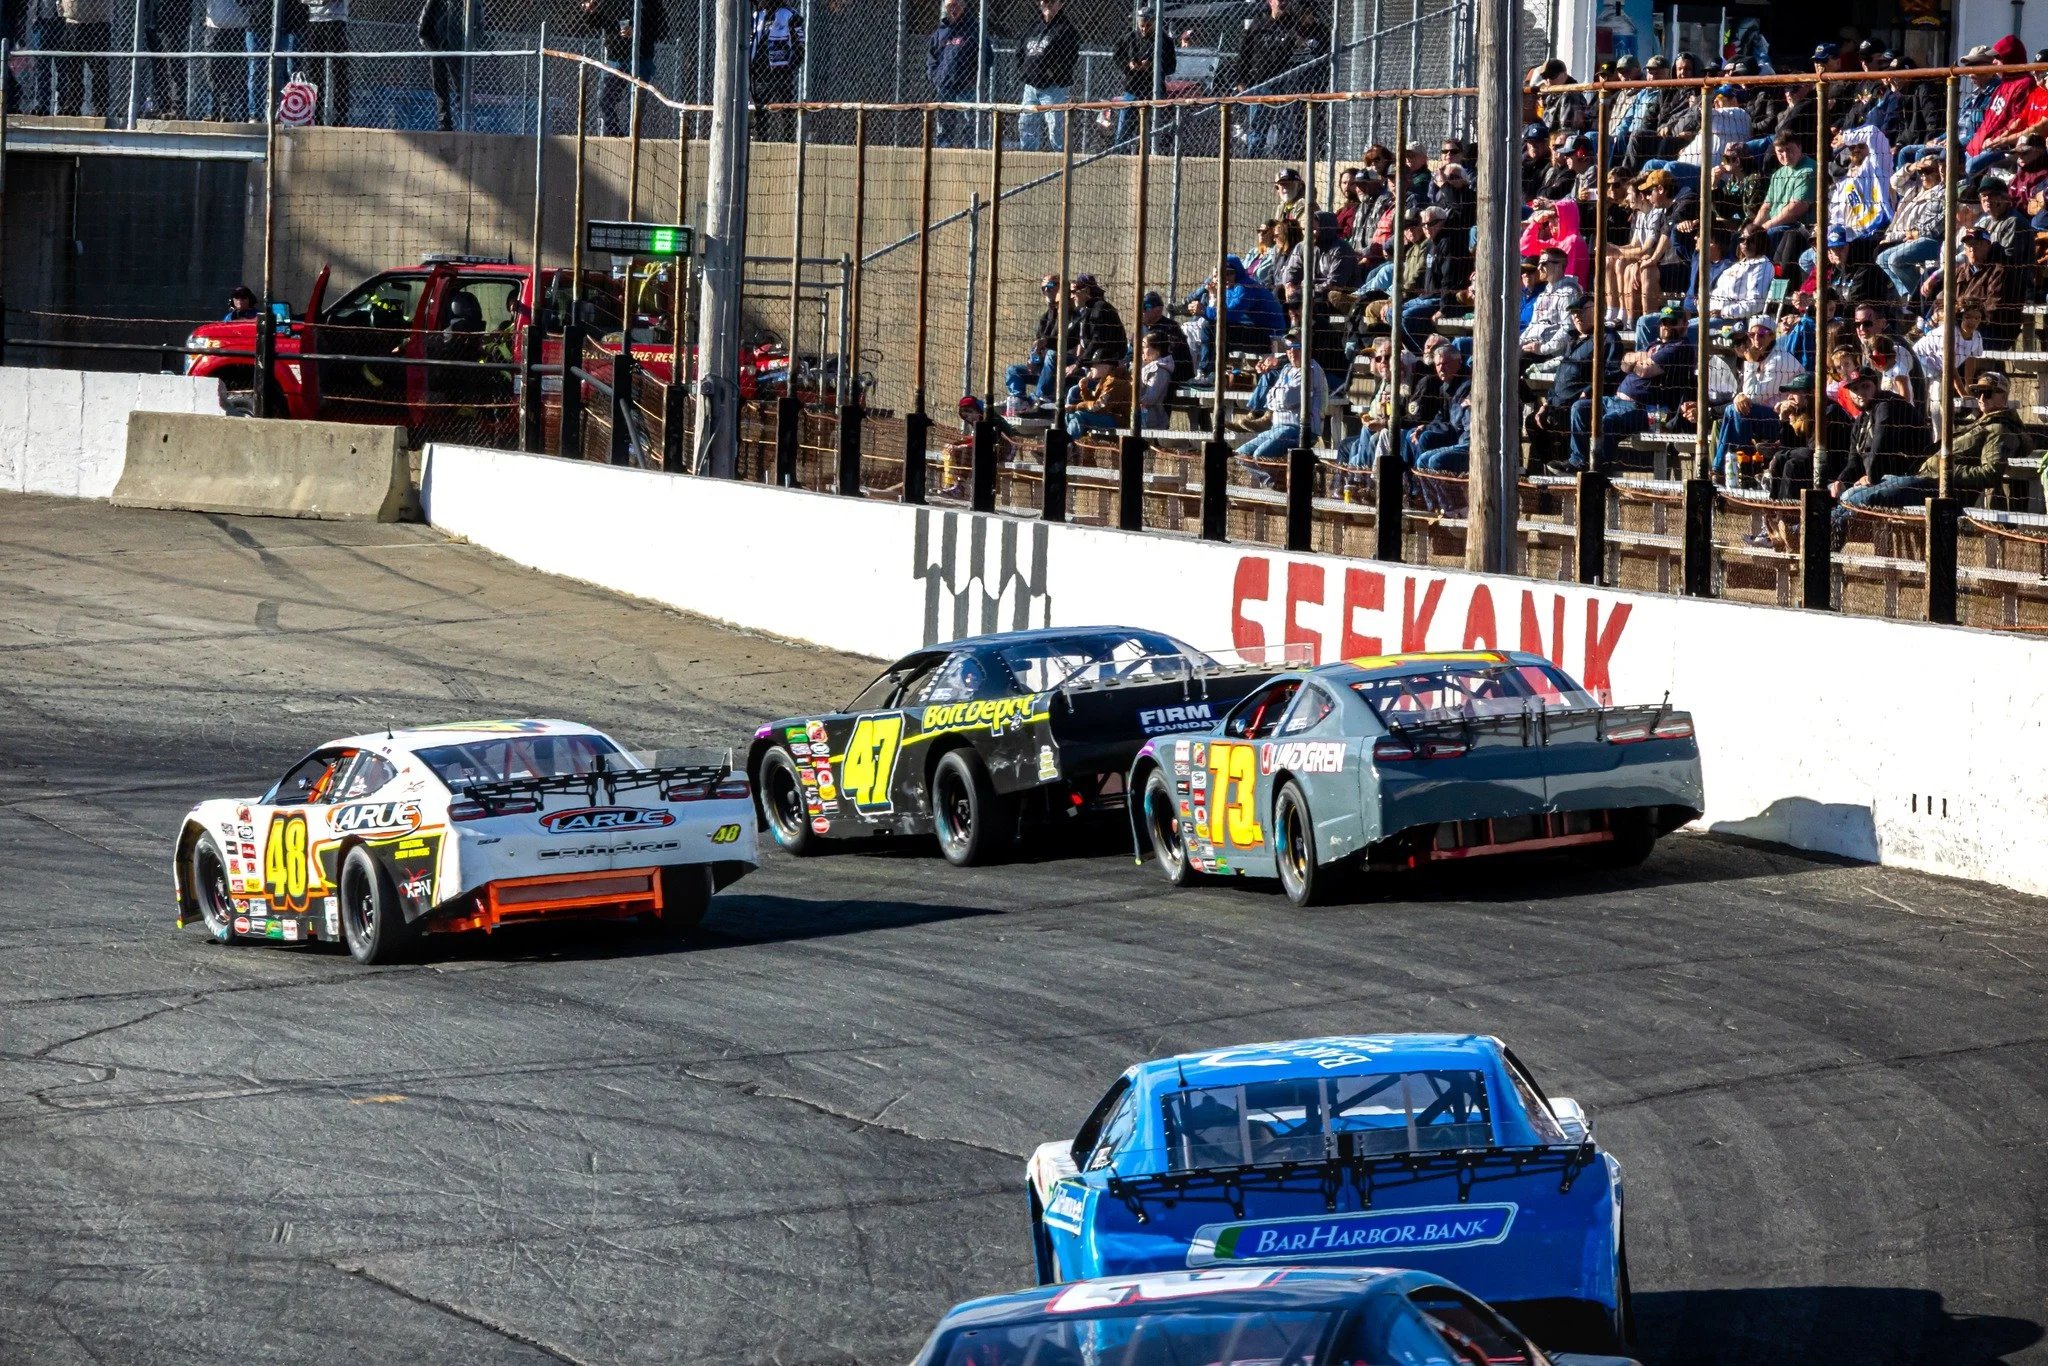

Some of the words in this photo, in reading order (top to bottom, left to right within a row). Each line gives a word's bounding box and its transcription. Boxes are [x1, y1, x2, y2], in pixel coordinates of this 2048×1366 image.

[1140, 704, 1211, 725] FIRM
[1144, 720, 1221, 733] FOUNDAT
[842, 714, 903, 811] 47
[1208, 742, 1264, 849] 73
[330, 800, 421, 840] LARUE
[548, 809, 668, 834] LARUE
[712, 824, 741, 843] 48
[265, 815, 308, 898] 48
[538, 840, 680, 860] CAMARO
